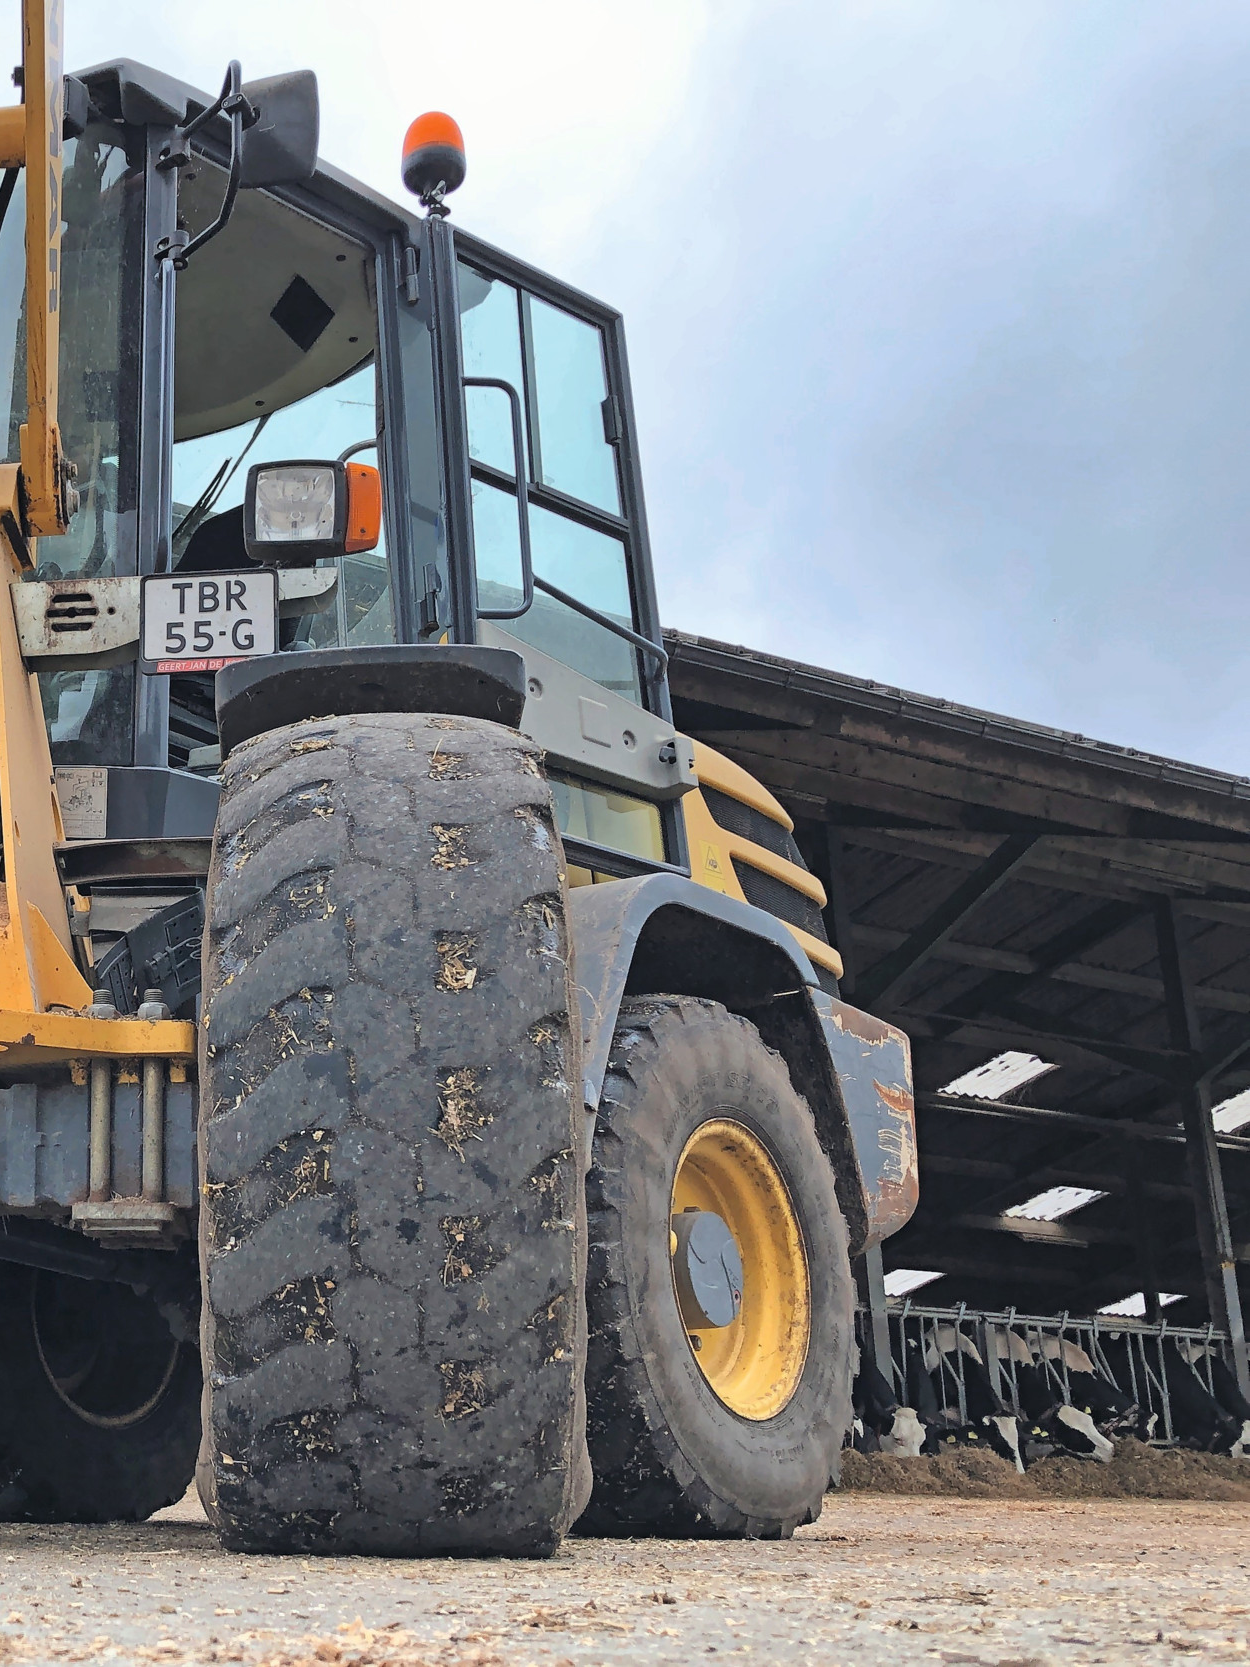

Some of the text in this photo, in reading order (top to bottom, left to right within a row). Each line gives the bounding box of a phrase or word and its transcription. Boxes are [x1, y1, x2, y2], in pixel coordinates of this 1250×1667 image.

[172, 580, 247, 614] TBR
[165, 618, 255, 654] 55-G
[158, 660, 207, 671] GEERT-JAN
[209, 659, 222, 669] DE
